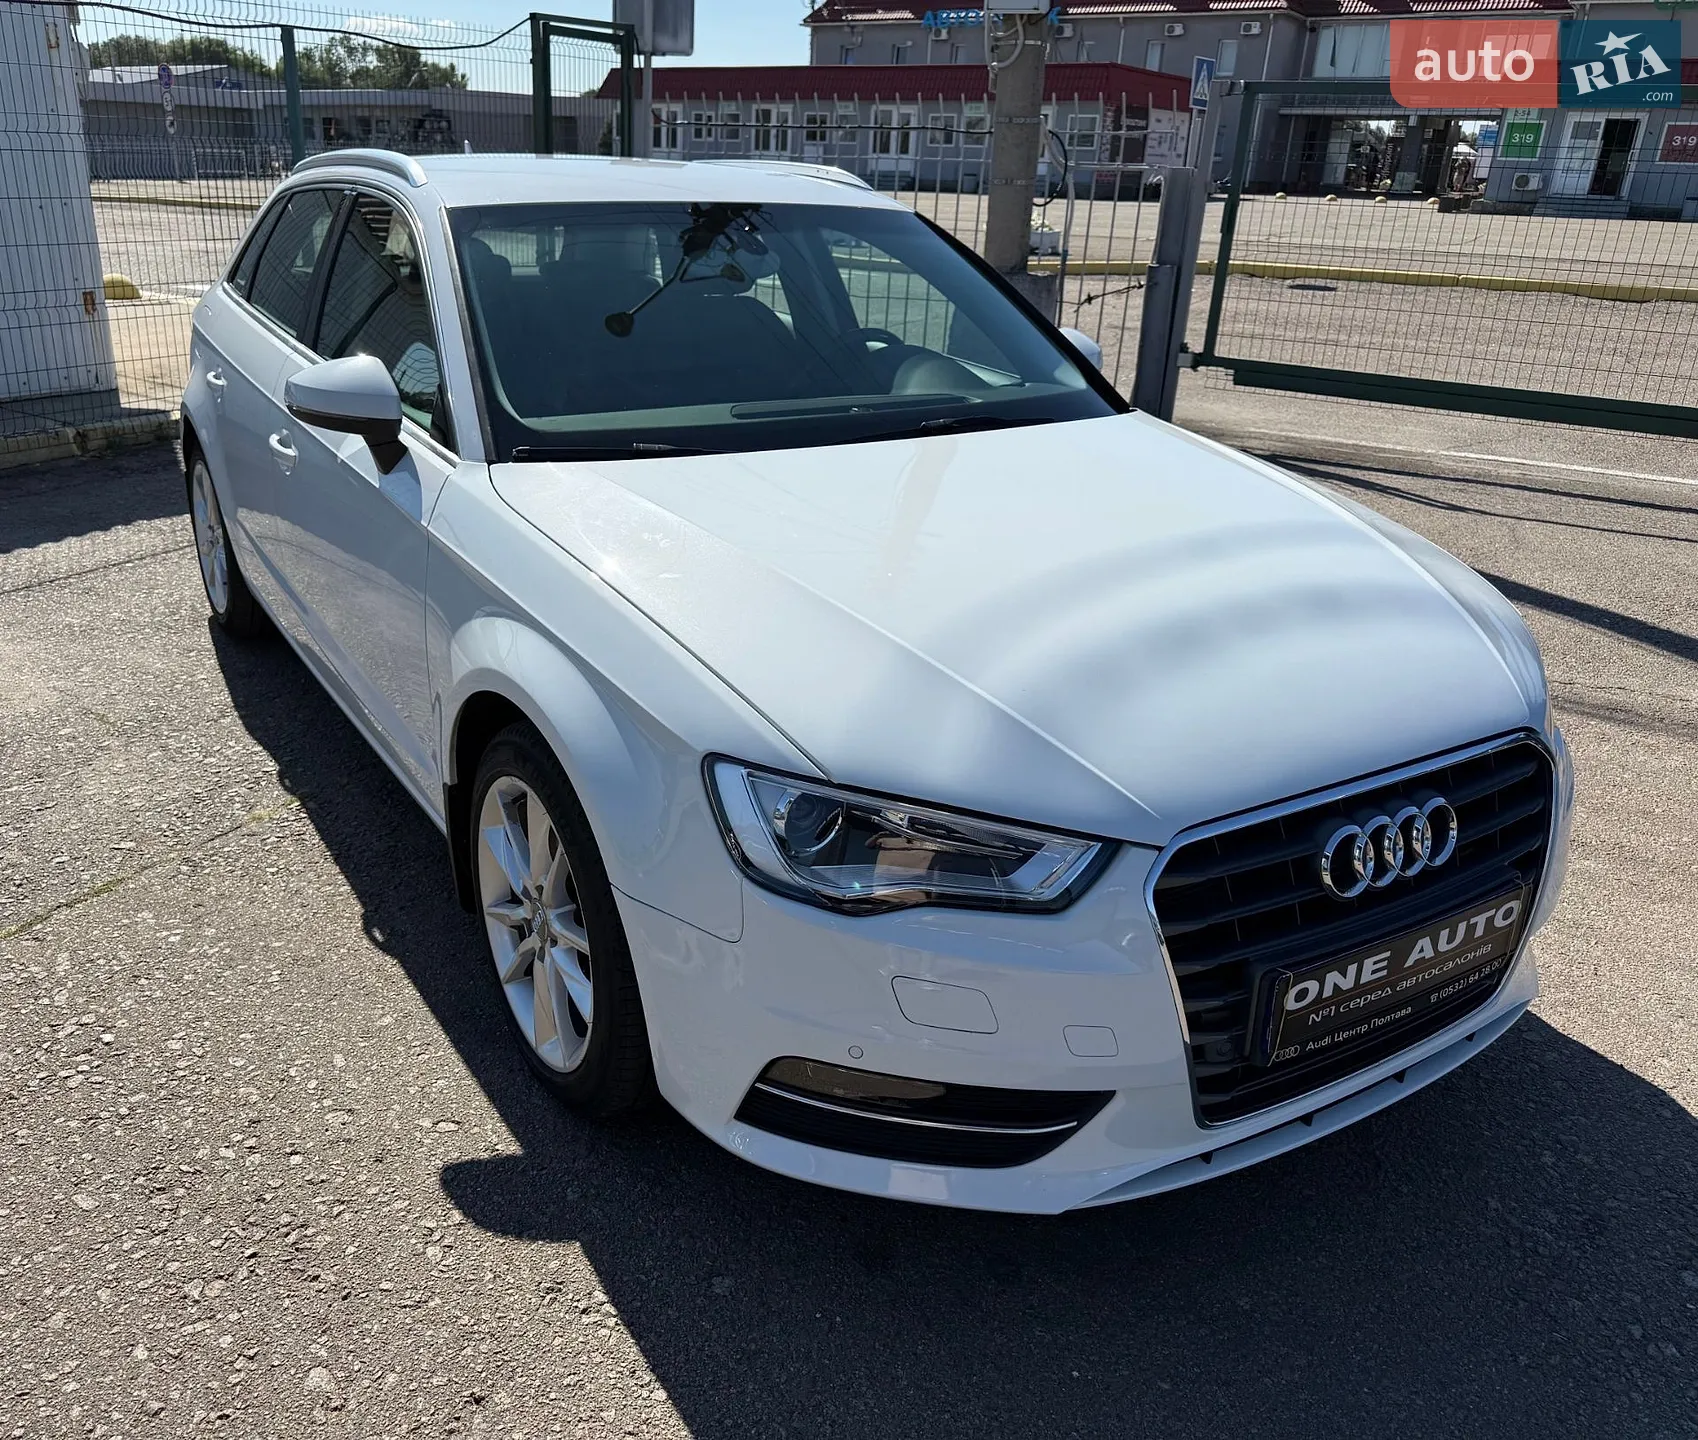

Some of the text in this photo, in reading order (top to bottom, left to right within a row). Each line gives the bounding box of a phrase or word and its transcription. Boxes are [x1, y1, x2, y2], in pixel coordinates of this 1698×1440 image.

[1512, 133, 1534, 144] 319
[1672, 135, 1697, 147] 319
[1284, 900, 1521, 1010] ONE AUTO
[1340, 987, 1392, 1013] серед
[1396, 943, 1492, 991] автосалонів
[1439, 978, 1468, 999] (0532)
[1468, 971, 1479, 984] 64
[1306, 1006, 1412, 1051] Audi Центр Полтава
